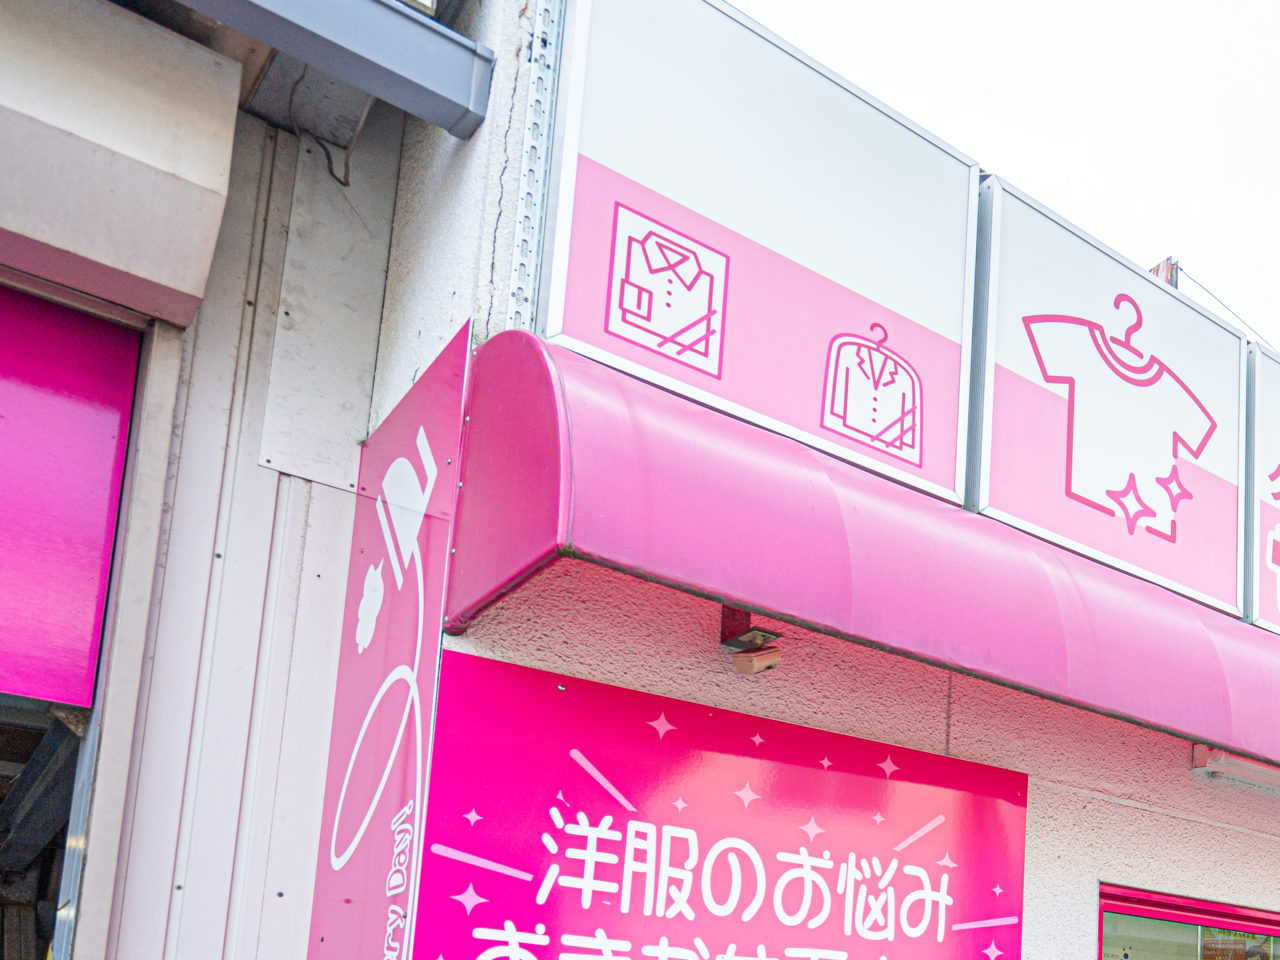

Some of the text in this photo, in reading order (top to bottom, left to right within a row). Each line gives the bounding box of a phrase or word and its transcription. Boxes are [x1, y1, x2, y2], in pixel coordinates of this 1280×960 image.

[536, 806, 953, 941] 洋服のお悩み
